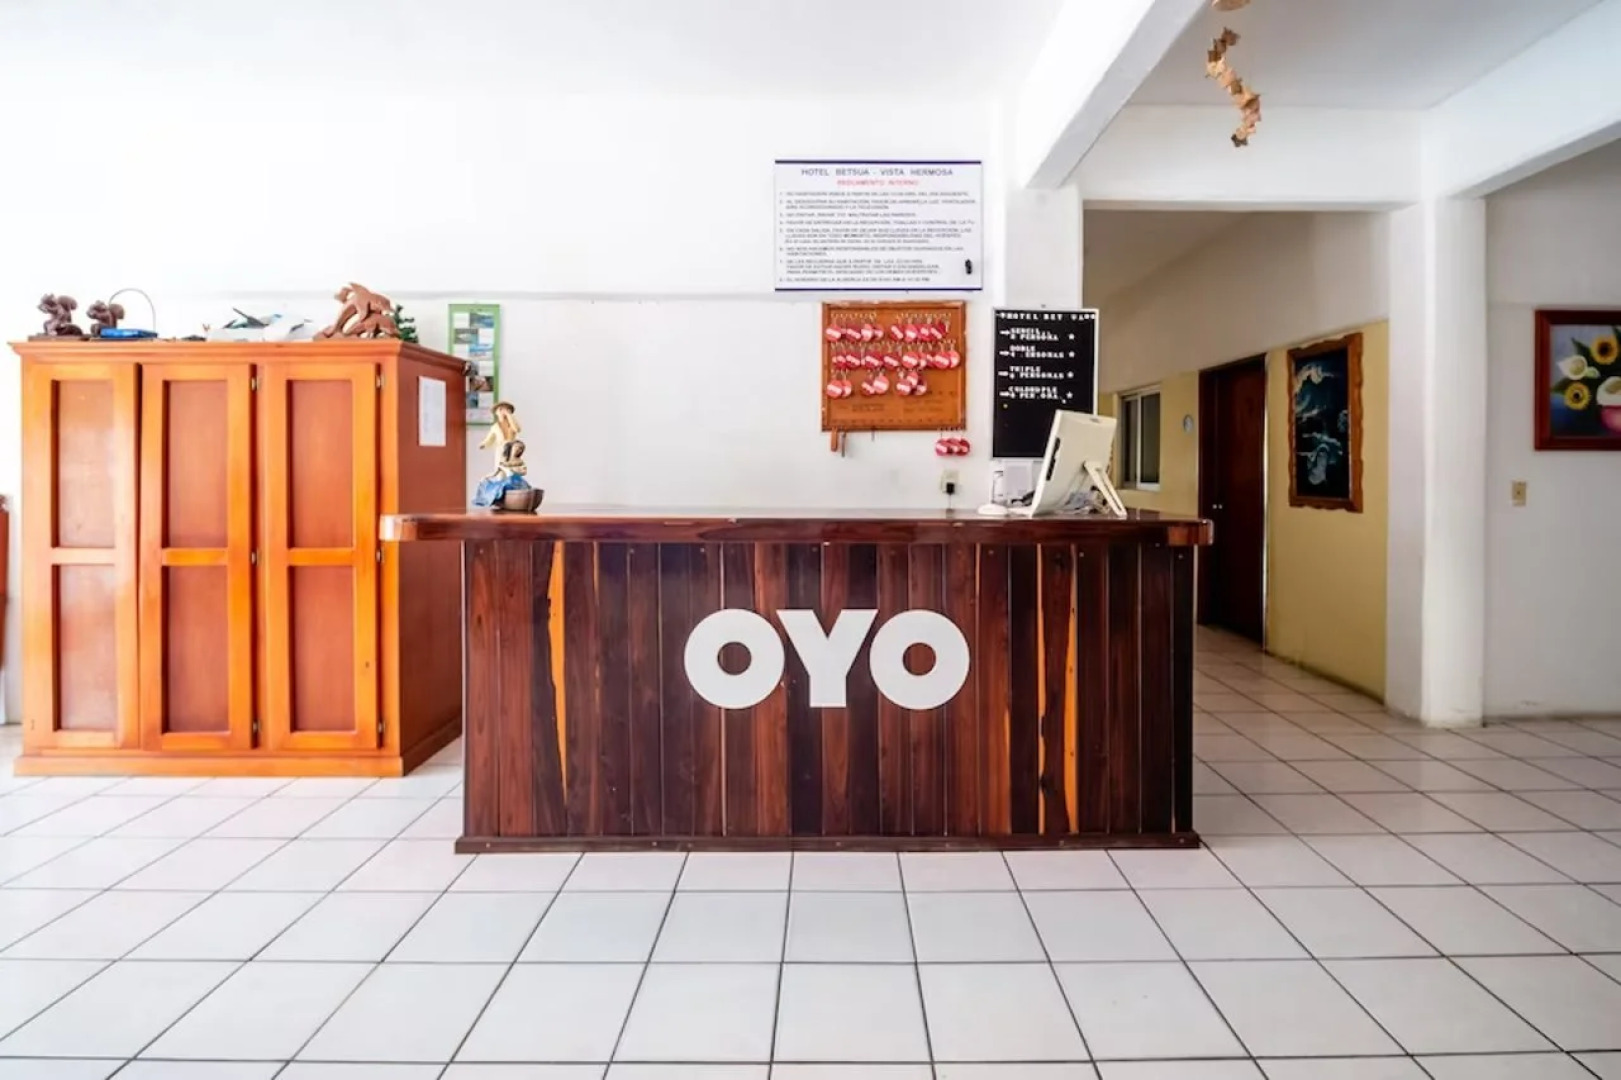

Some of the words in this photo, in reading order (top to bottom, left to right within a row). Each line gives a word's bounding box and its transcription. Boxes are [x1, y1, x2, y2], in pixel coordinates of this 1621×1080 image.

[801, 168, 829, 176] HOTEL
[835, 168, 869, 176] BETSUA
[880, 168, 904, 176] VISTA
[910, 168, 953, 176] HERMOSA
[1006, 312, 1039, 320] HOTEL
[684, 608, 970, 710] OYO
